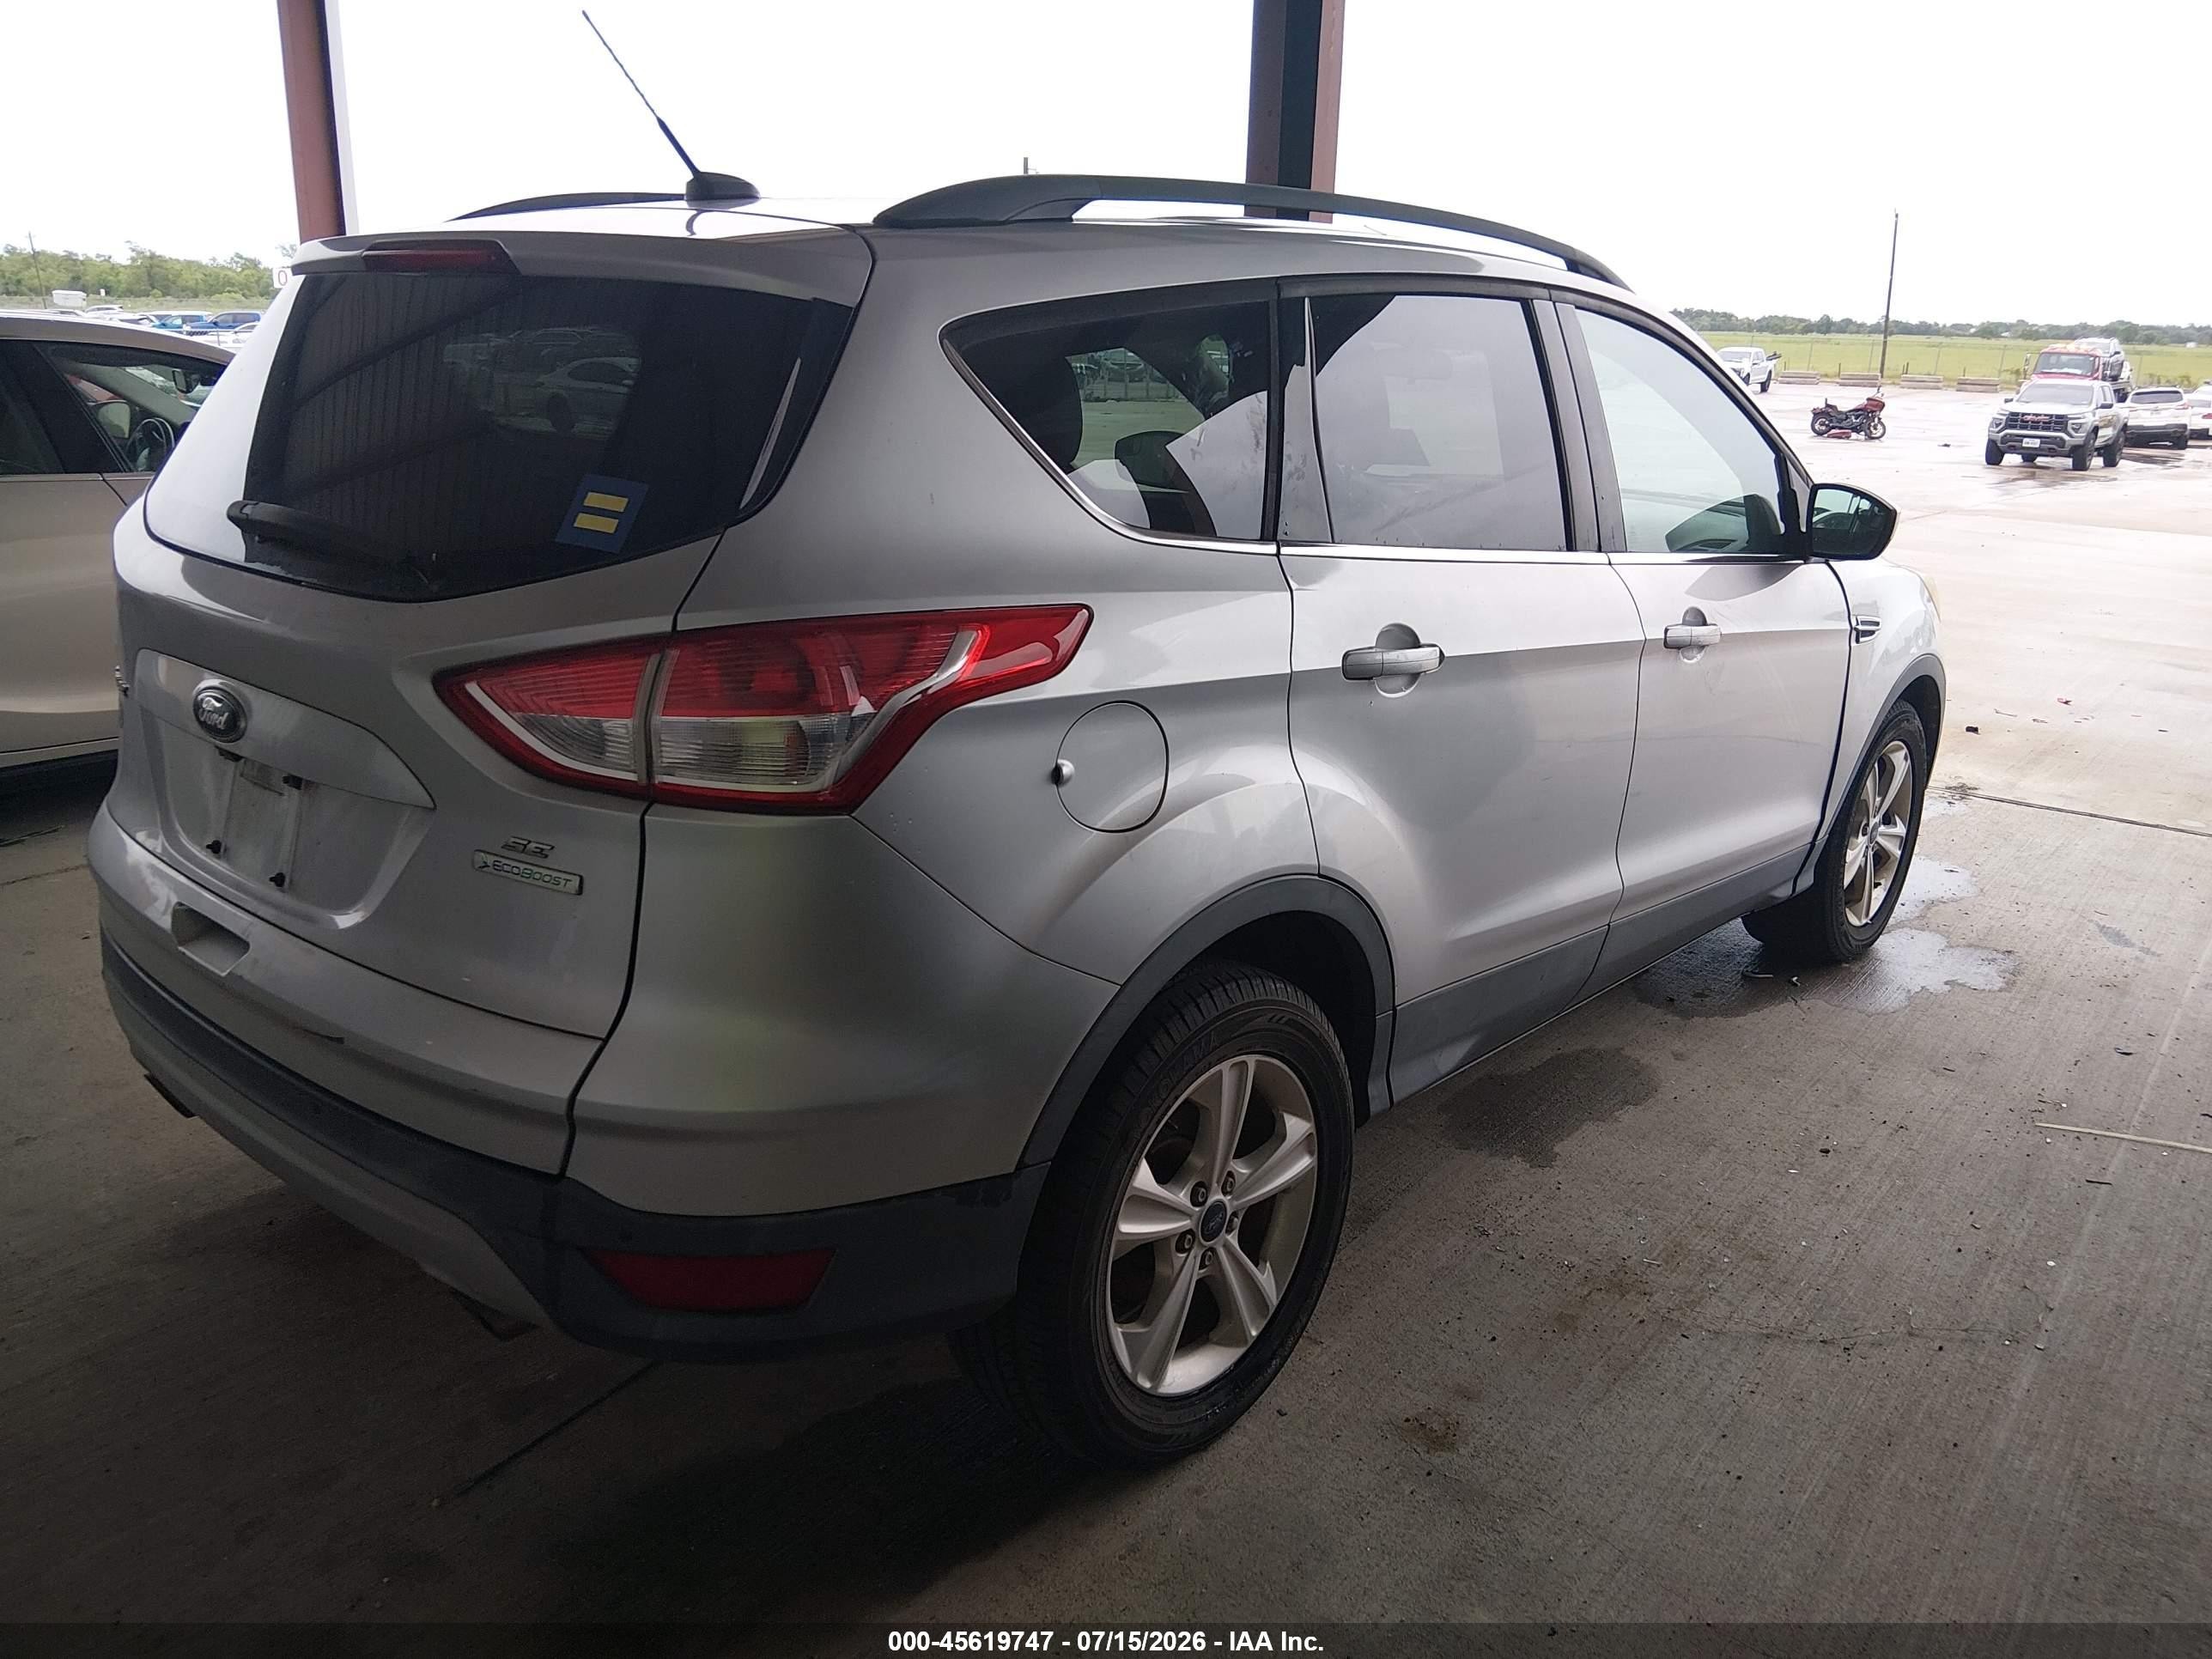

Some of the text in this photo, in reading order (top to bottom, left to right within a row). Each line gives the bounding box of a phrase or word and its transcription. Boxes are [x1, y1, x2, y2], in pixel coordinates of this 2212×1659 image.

[198, 696, 229, 730] Ford
[501, 835, 556, 859] SE
[491, 860, 573, 887] ECOBOOST
